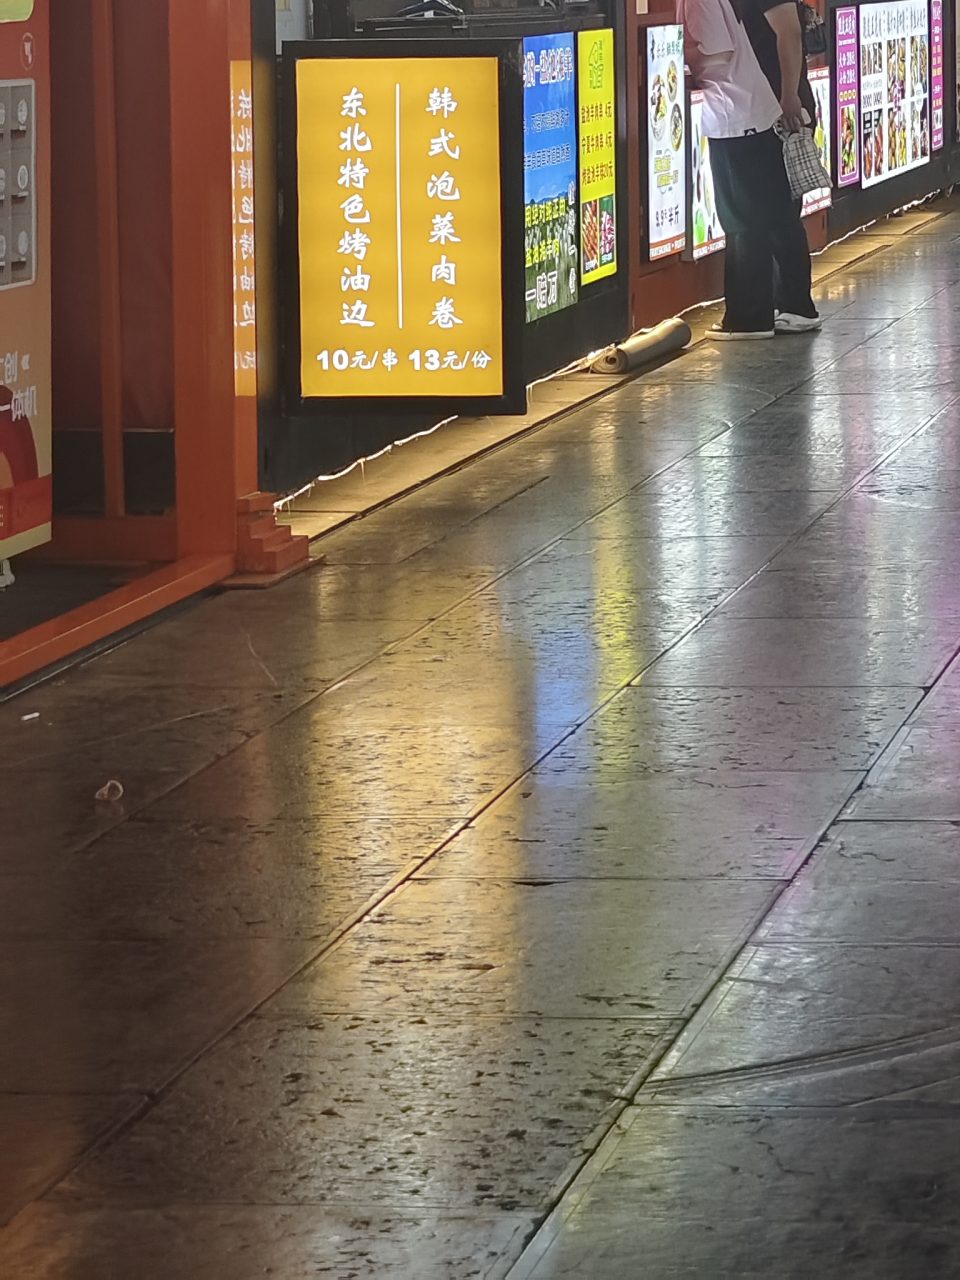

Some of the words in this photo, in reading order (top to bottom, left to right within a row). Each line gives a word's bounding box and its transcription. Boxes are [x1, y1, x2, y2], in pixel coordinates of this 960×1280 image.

[336, 86, 376, 328] 东北特色烤油边
[425, 86, 464, 329] 韩式泡菜肉卷
[316, 348, 399, 371] 10元/串
[408, 348, 492, 371] 13元/份
